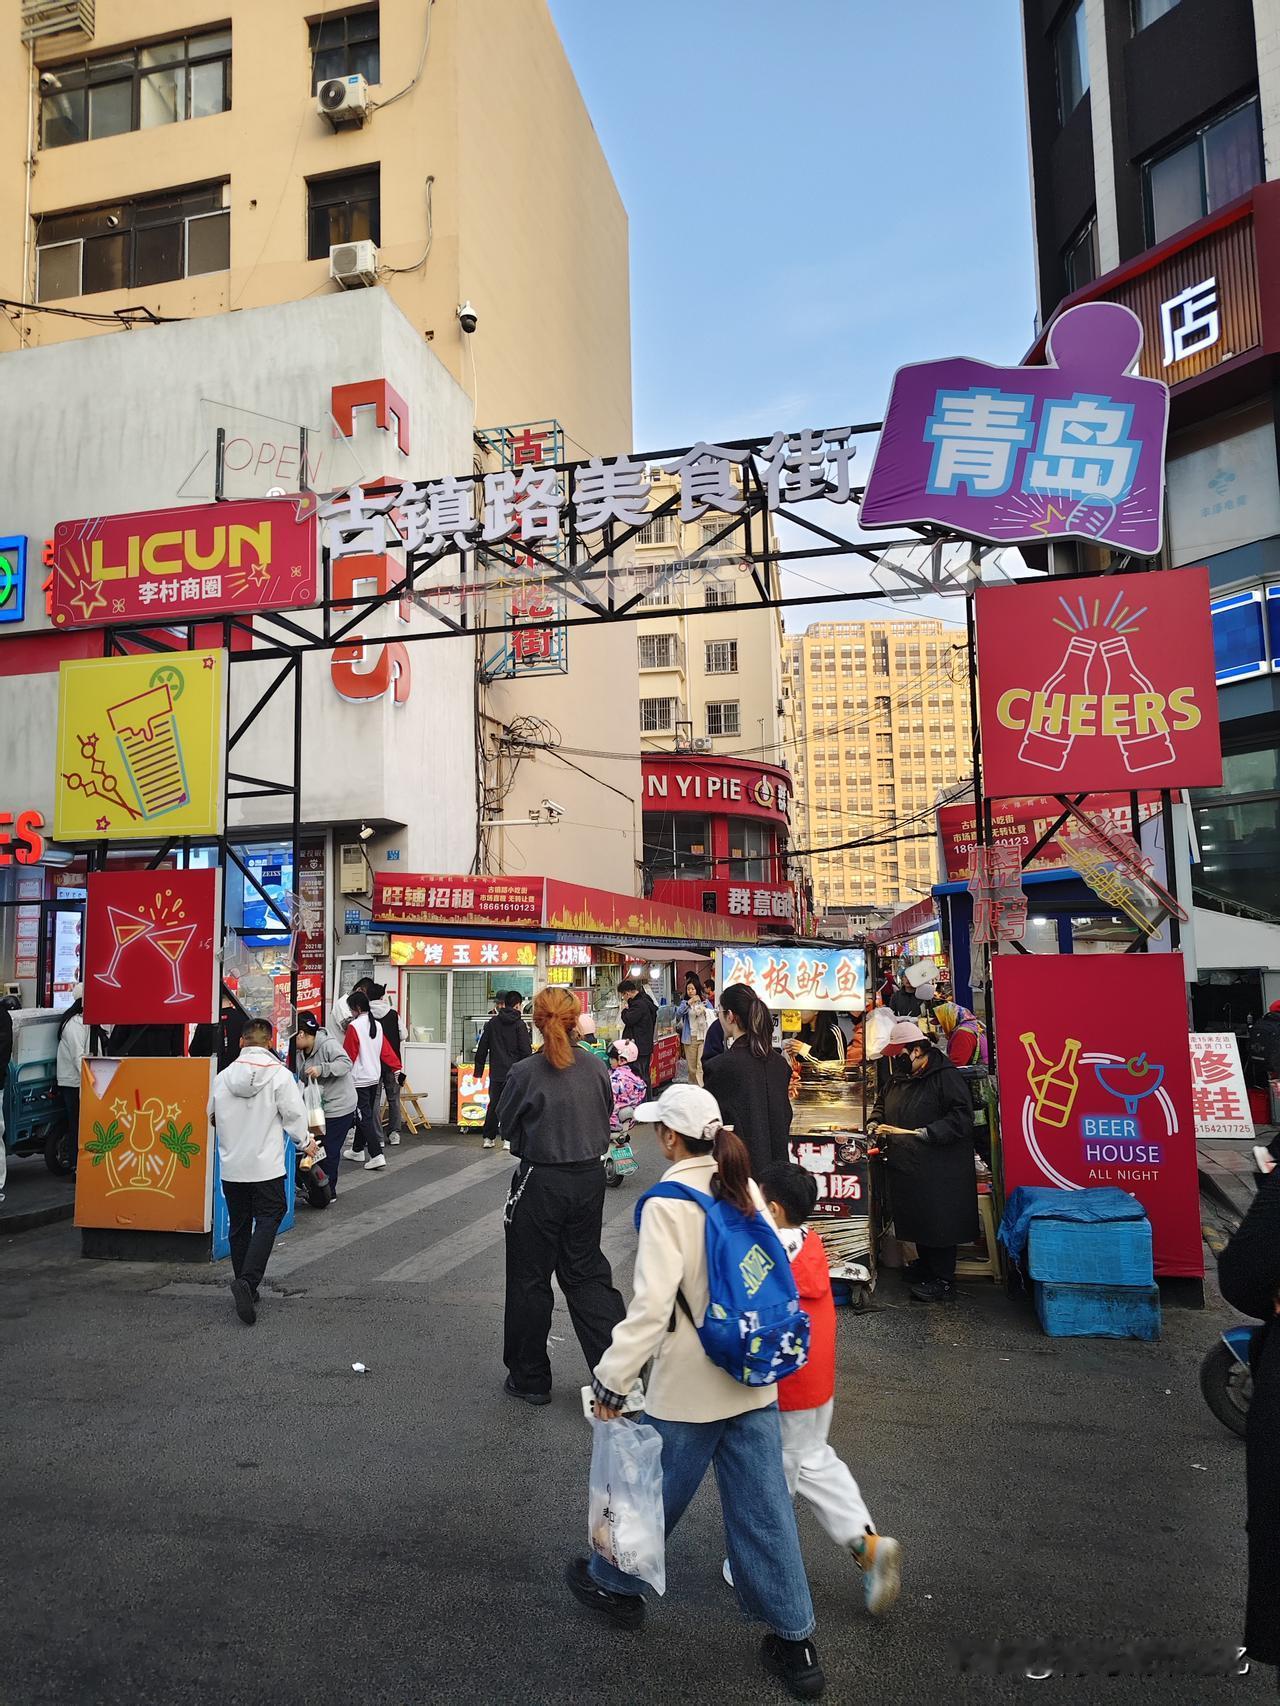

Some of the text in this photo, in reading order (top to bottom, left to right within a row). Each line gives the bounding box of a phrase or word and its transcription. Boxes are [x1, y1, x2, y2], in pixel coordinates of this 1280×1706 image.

[1160, 276, 1221, 367] 店
[223, 438, 324, 485] OPEN
[930, 392, 1137, 503] 青岛
[317, 427, 857, 559] 古镇路美食街
[91, 520, 272, 583] LICUN
[138, 574, 222, 605] 李村商圈
[996, 685, 1202, 736] CHEERS
[675, 775, 701, 798] YI
[707, 776, 742, 801] PIE
[381, 886, 475, 910] 旺铺招租
[478, 902, 536, 912] 18661610123
[423, 944, 500, 965] 烤玉米
[728, 956, 862, 1002] 铁板鱿鱼
[1084, 1118, 1136, 1138] BEER
[1086, 1144, 1160, 1164] HOUSE
[1088, 1168, 1160, 1182] ALL NIGHT
